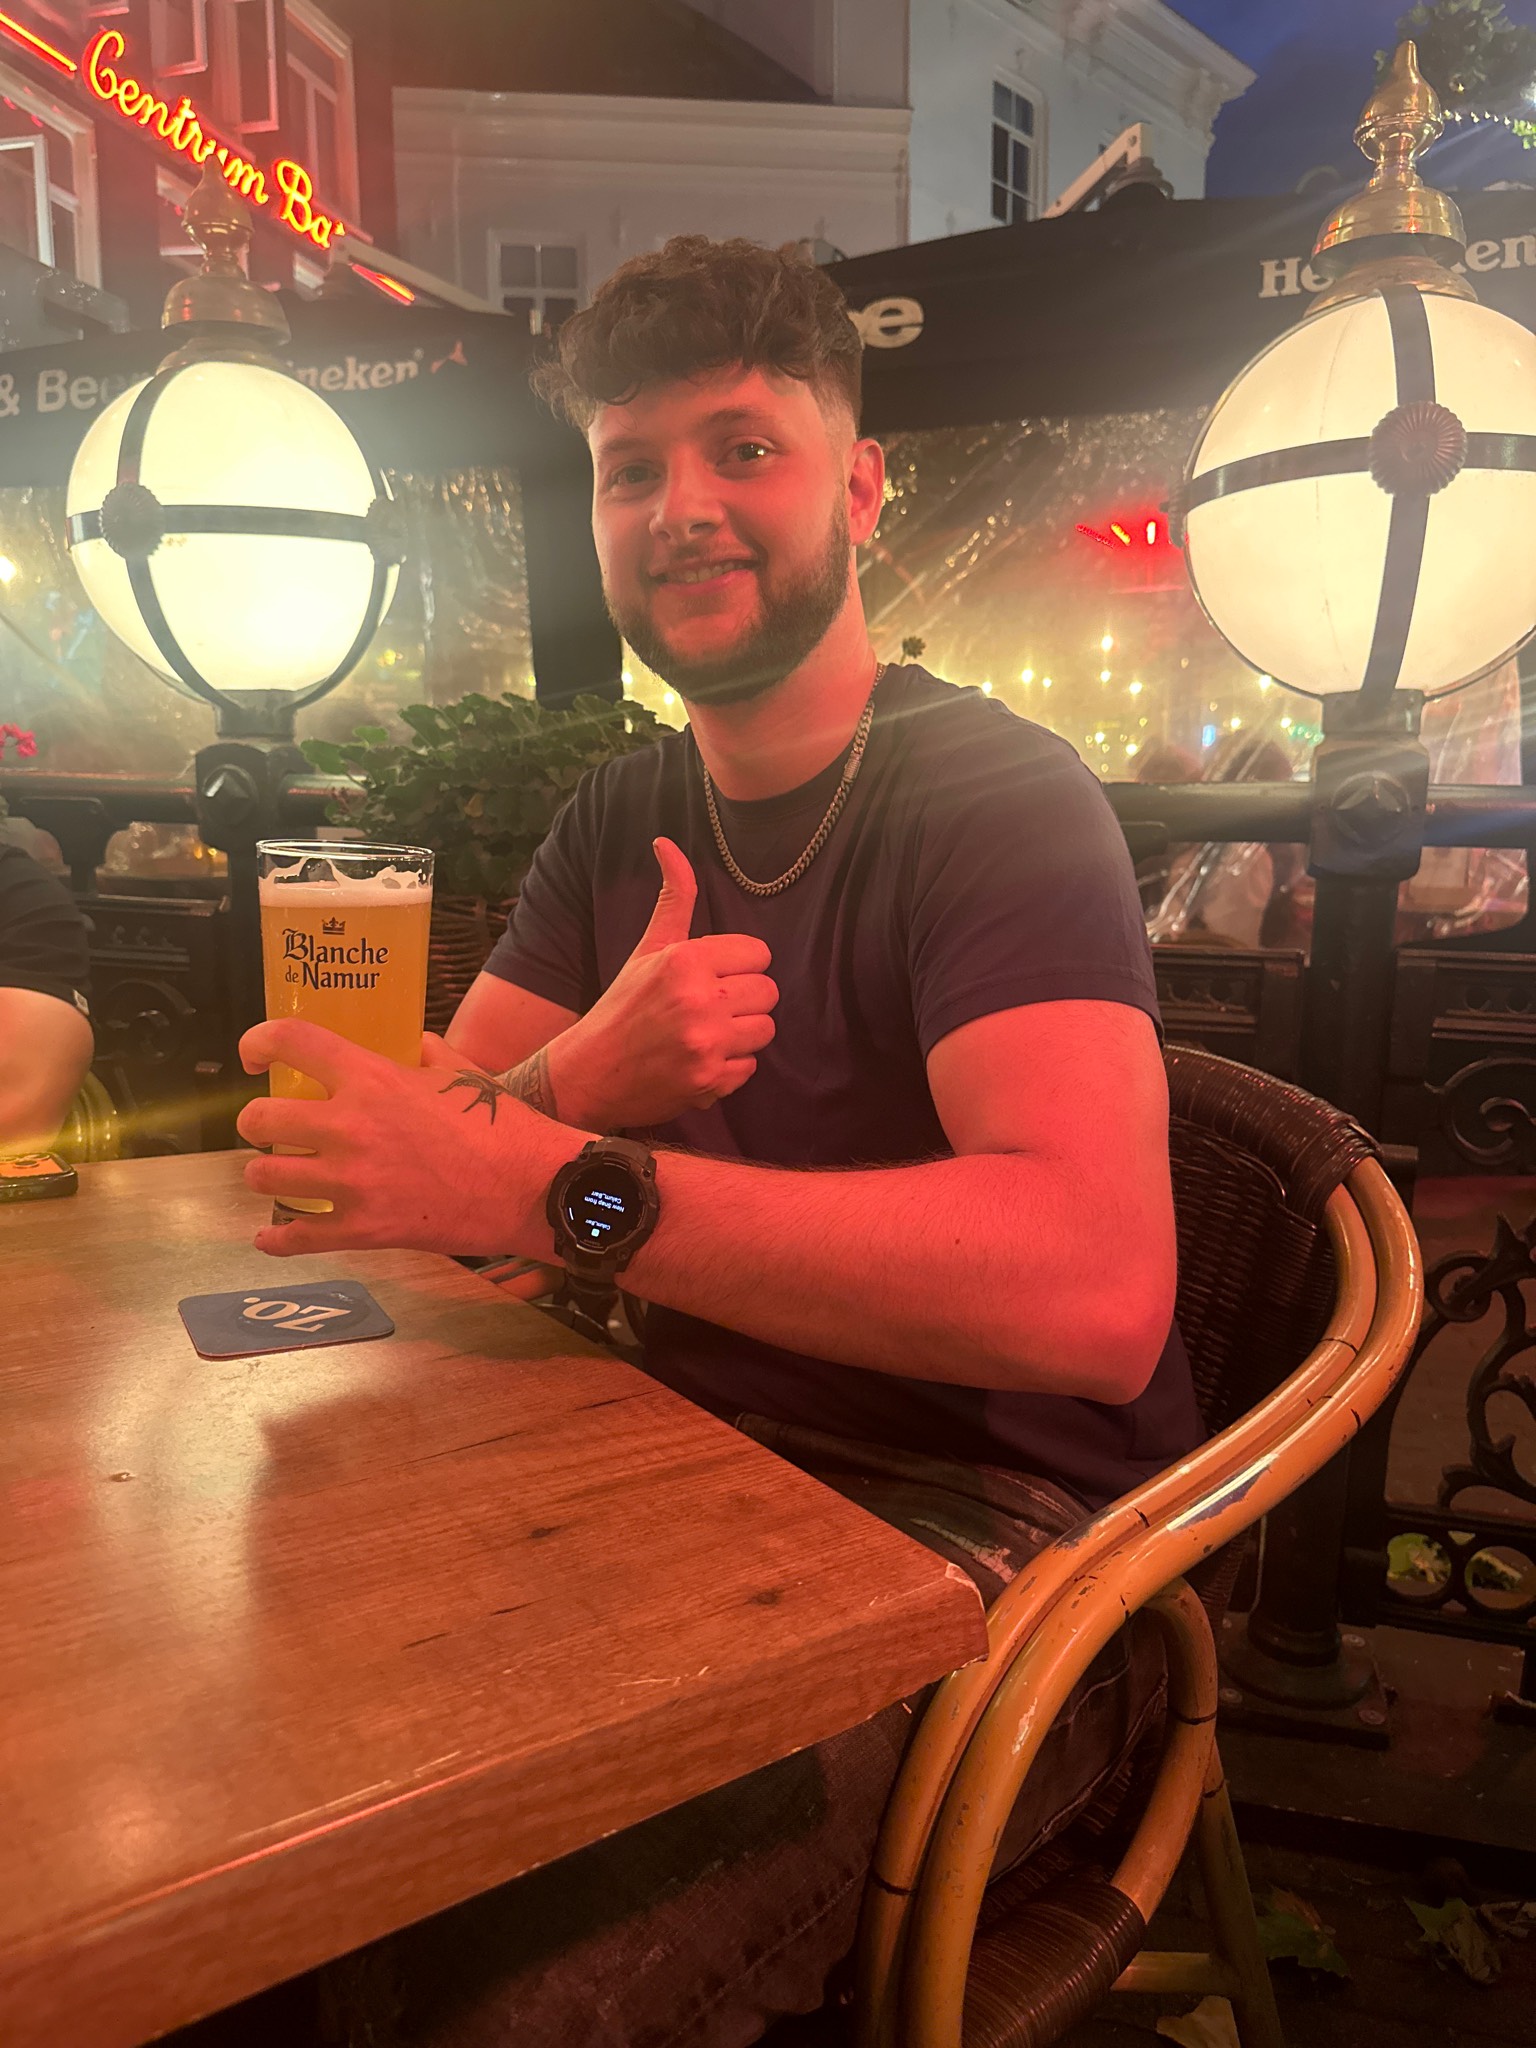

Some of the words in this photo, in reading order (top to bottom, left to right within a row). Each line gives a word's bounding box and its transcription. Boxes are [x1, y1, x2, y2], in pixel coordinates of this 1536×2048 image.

[276, 159, 345, 249] Ba
[282, 928, 389, 965] Blanche
[285, 965, 300, 984] de
[301, 961, 381, 990] Namur
[584, 1196, 597, 1205] from
[598, 1200, 611, 1209] Snap
[612, 1204, 624, 1212] New
